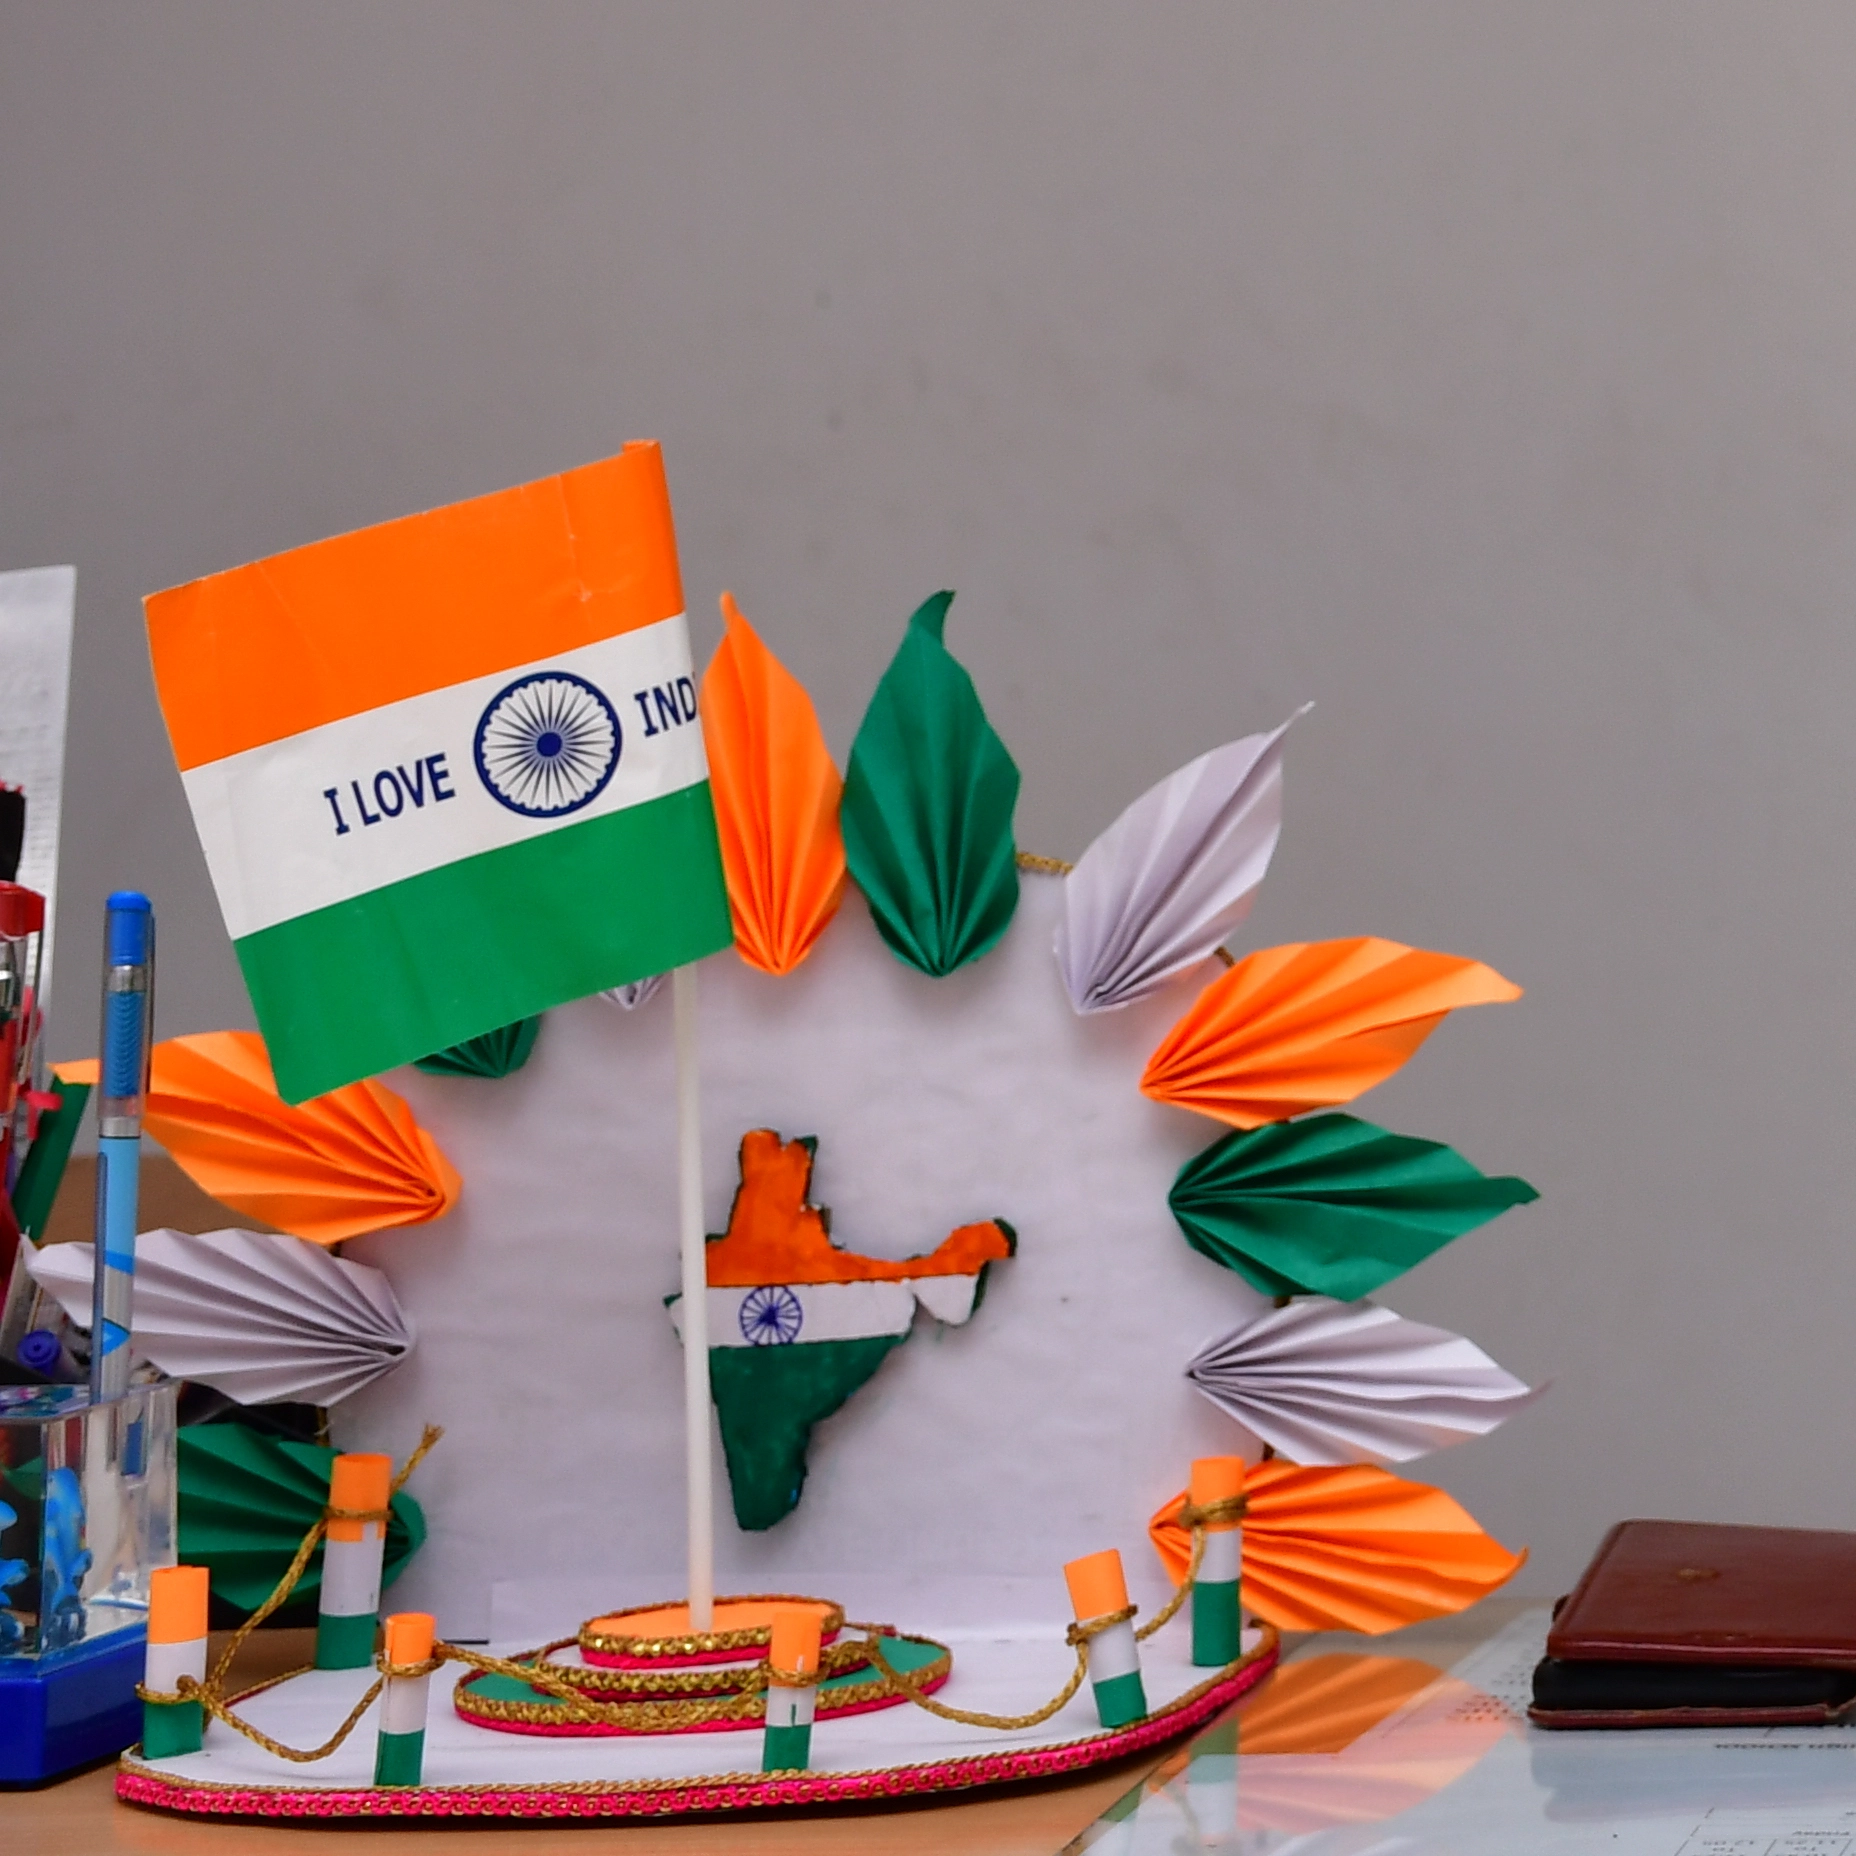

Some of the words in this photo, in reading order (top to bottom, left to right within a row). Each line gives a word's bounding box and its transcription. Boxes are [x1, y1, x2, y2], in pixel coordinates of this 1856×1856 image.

[633, 676, 698, 738] IND
[323, 787, 350, 836] I
[351, 752, 456, 827] LOVE
